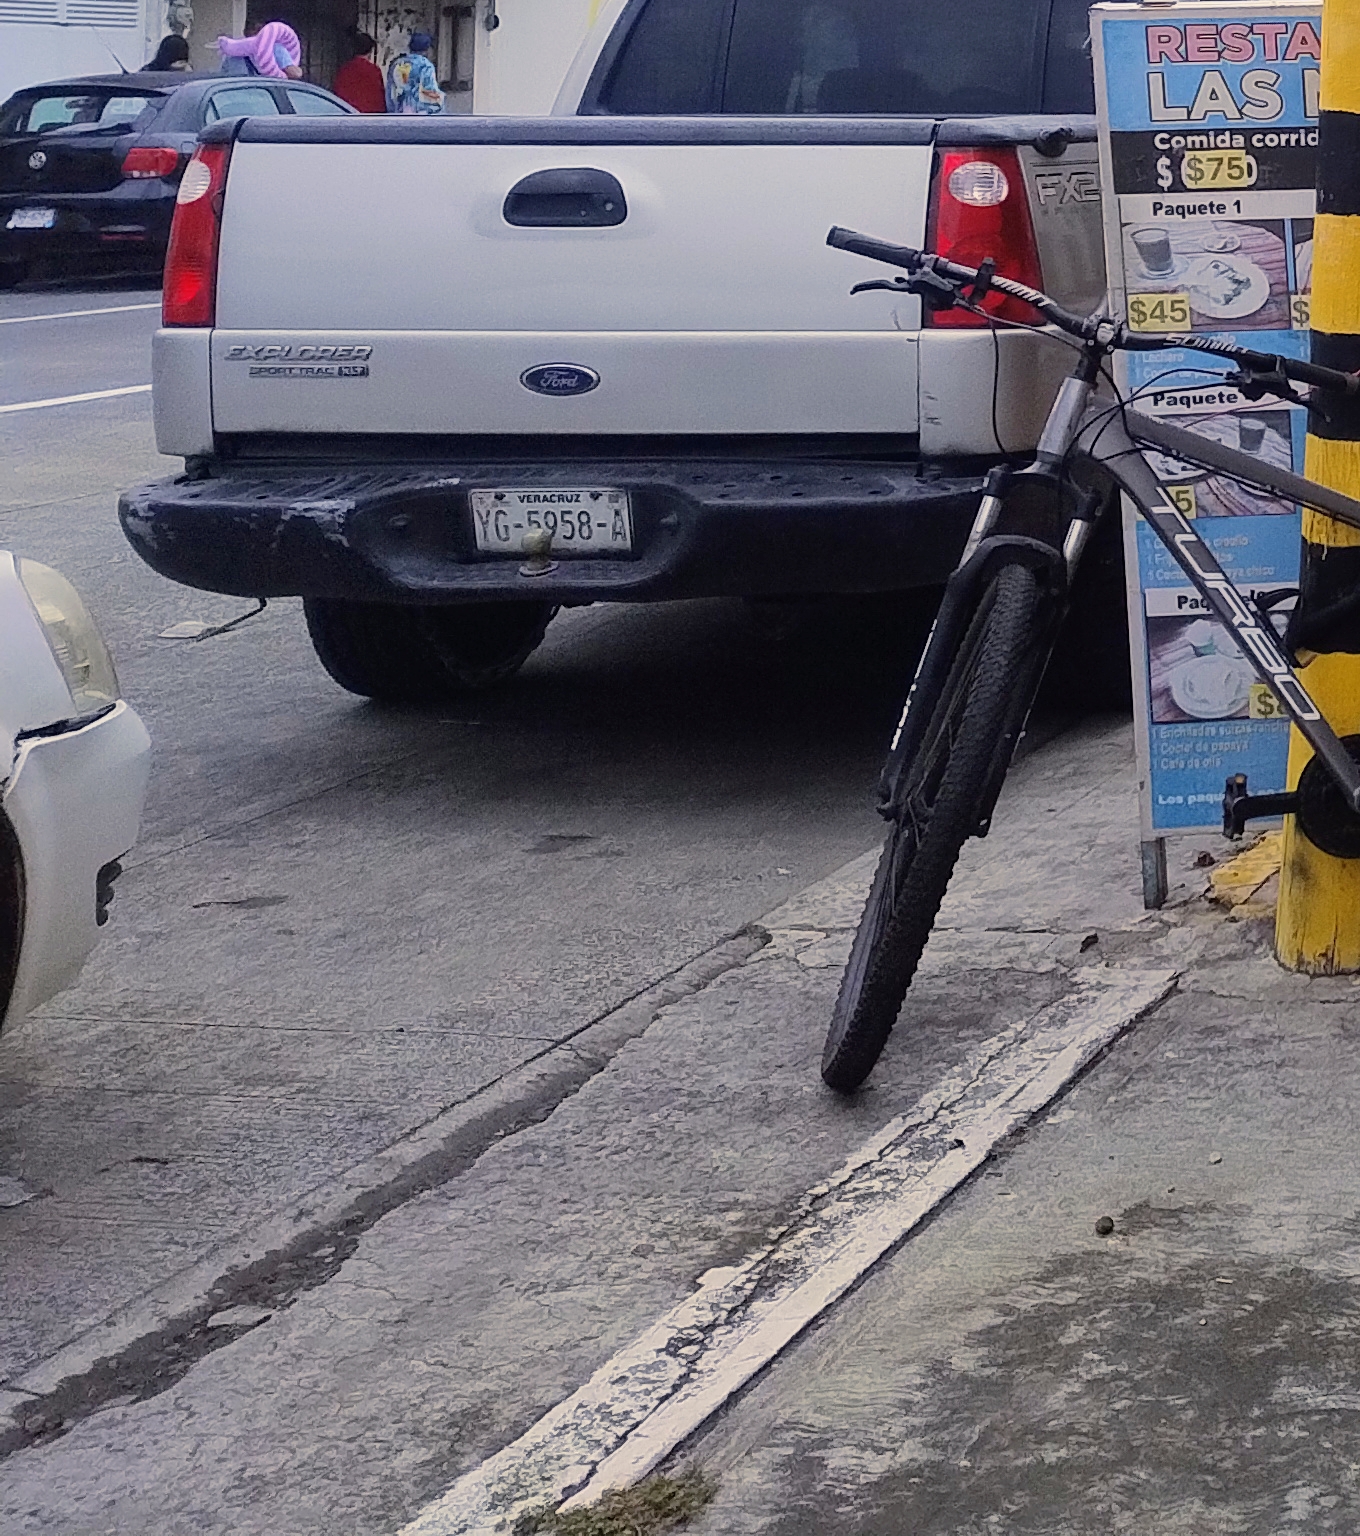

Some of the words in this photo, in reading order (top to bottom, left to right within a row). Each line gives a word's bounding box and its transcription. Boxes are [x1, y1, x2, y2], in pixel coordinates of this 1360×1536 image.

[1146, 68, 1284, 123] LAS
[1154, 130, 1245, 151] Comida
[1251, 129, 1320, 148] corrid
[1185, 155, 1245, 185] $75
[1152, 200, 1227, 219] Paquete
[1232, 200, 1243, 214] 1
[1129, 297, 1188, 327] $45
[224, 345, 374, 362] EXPLORER
[540, 370, 580, 388] Ford
[1153, 390, 1239, 409] Paquete
[517, 493, 582, 504] VERACRUZ
[475, 508, 628, 543] YG-5958-A
[1150, 486, 1321, 721] TURBO
